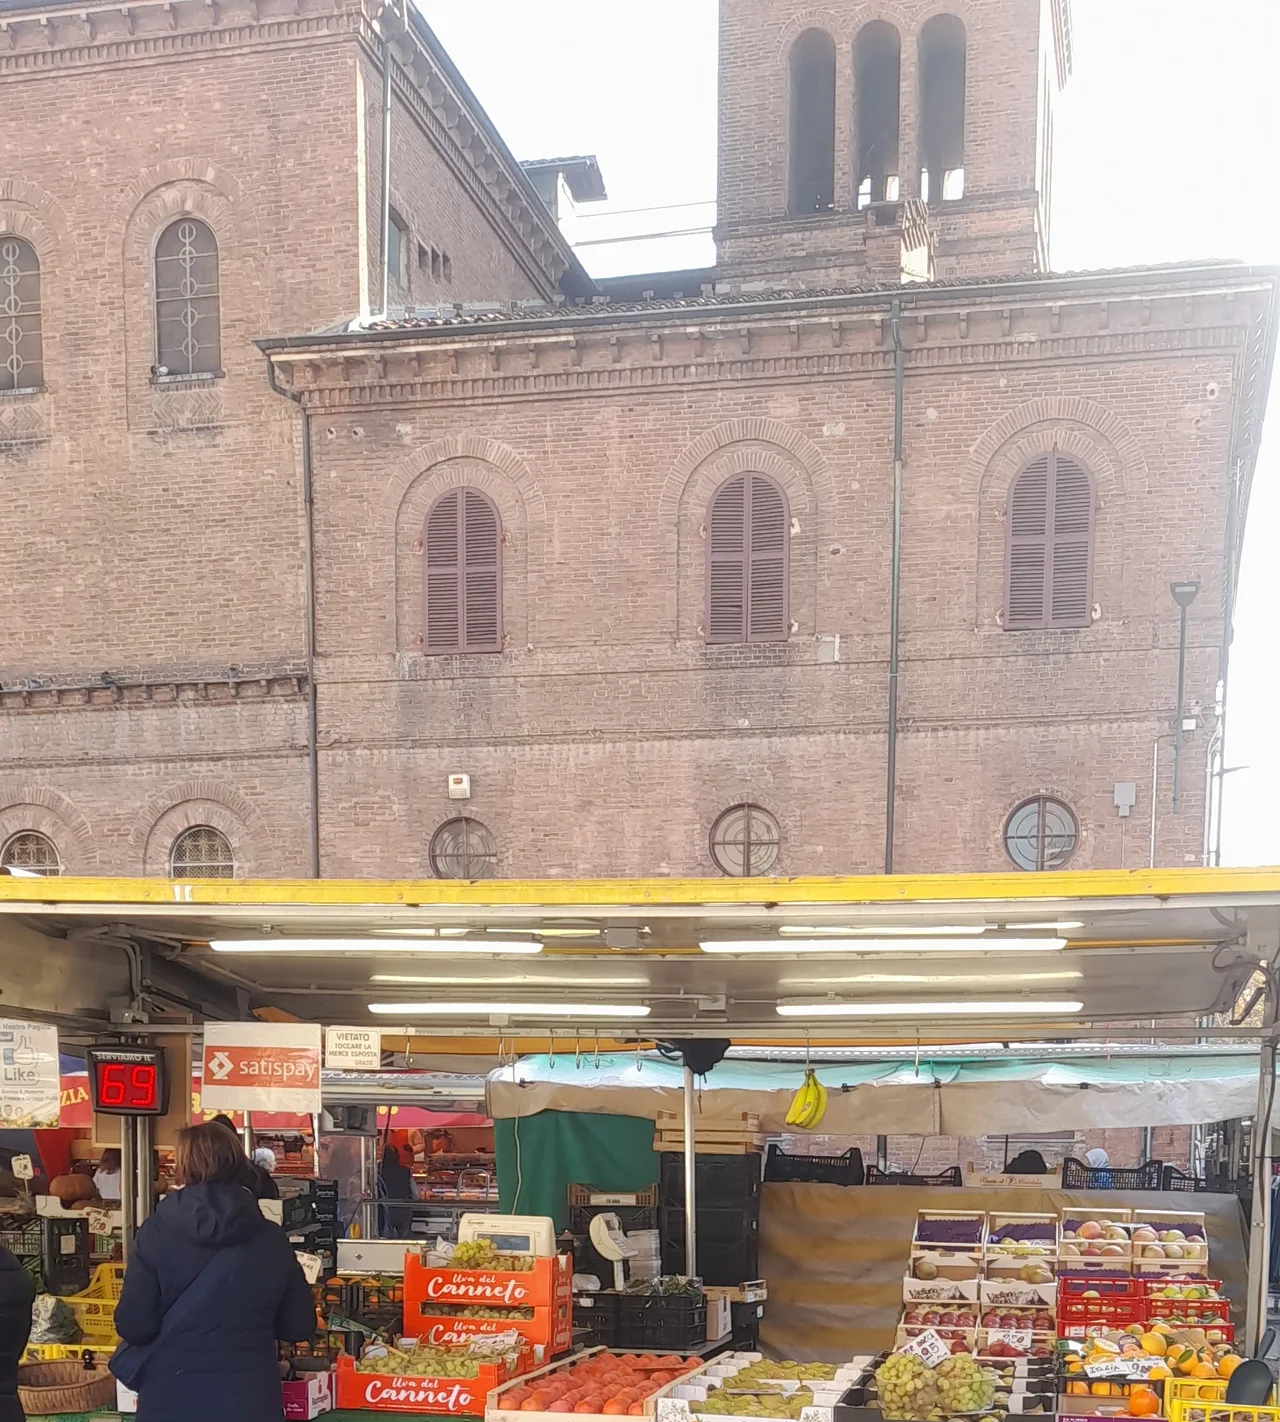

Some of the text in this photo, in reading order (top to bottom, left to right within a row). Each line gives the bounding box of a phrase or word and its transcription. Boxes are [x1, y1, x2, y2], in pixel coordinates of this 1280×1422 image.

[336, 1032, 370, 1041] VIETATO
[335, 1042, 363, 1050] TOCCARE
[4, 1067, 35, 1081] Like
[239, 1058, 318, 1082] satispay
[101, 1064, 156, 1105] 69
[452, 1273, 496, 1283] Uva del
[427, 1276, 530, 1304] Canneto
[453, 1321, 497, 1332] Uva del
[392, 1377, 439, 1388] Uva del
[365, 1380, 476, 1411] Canneto
